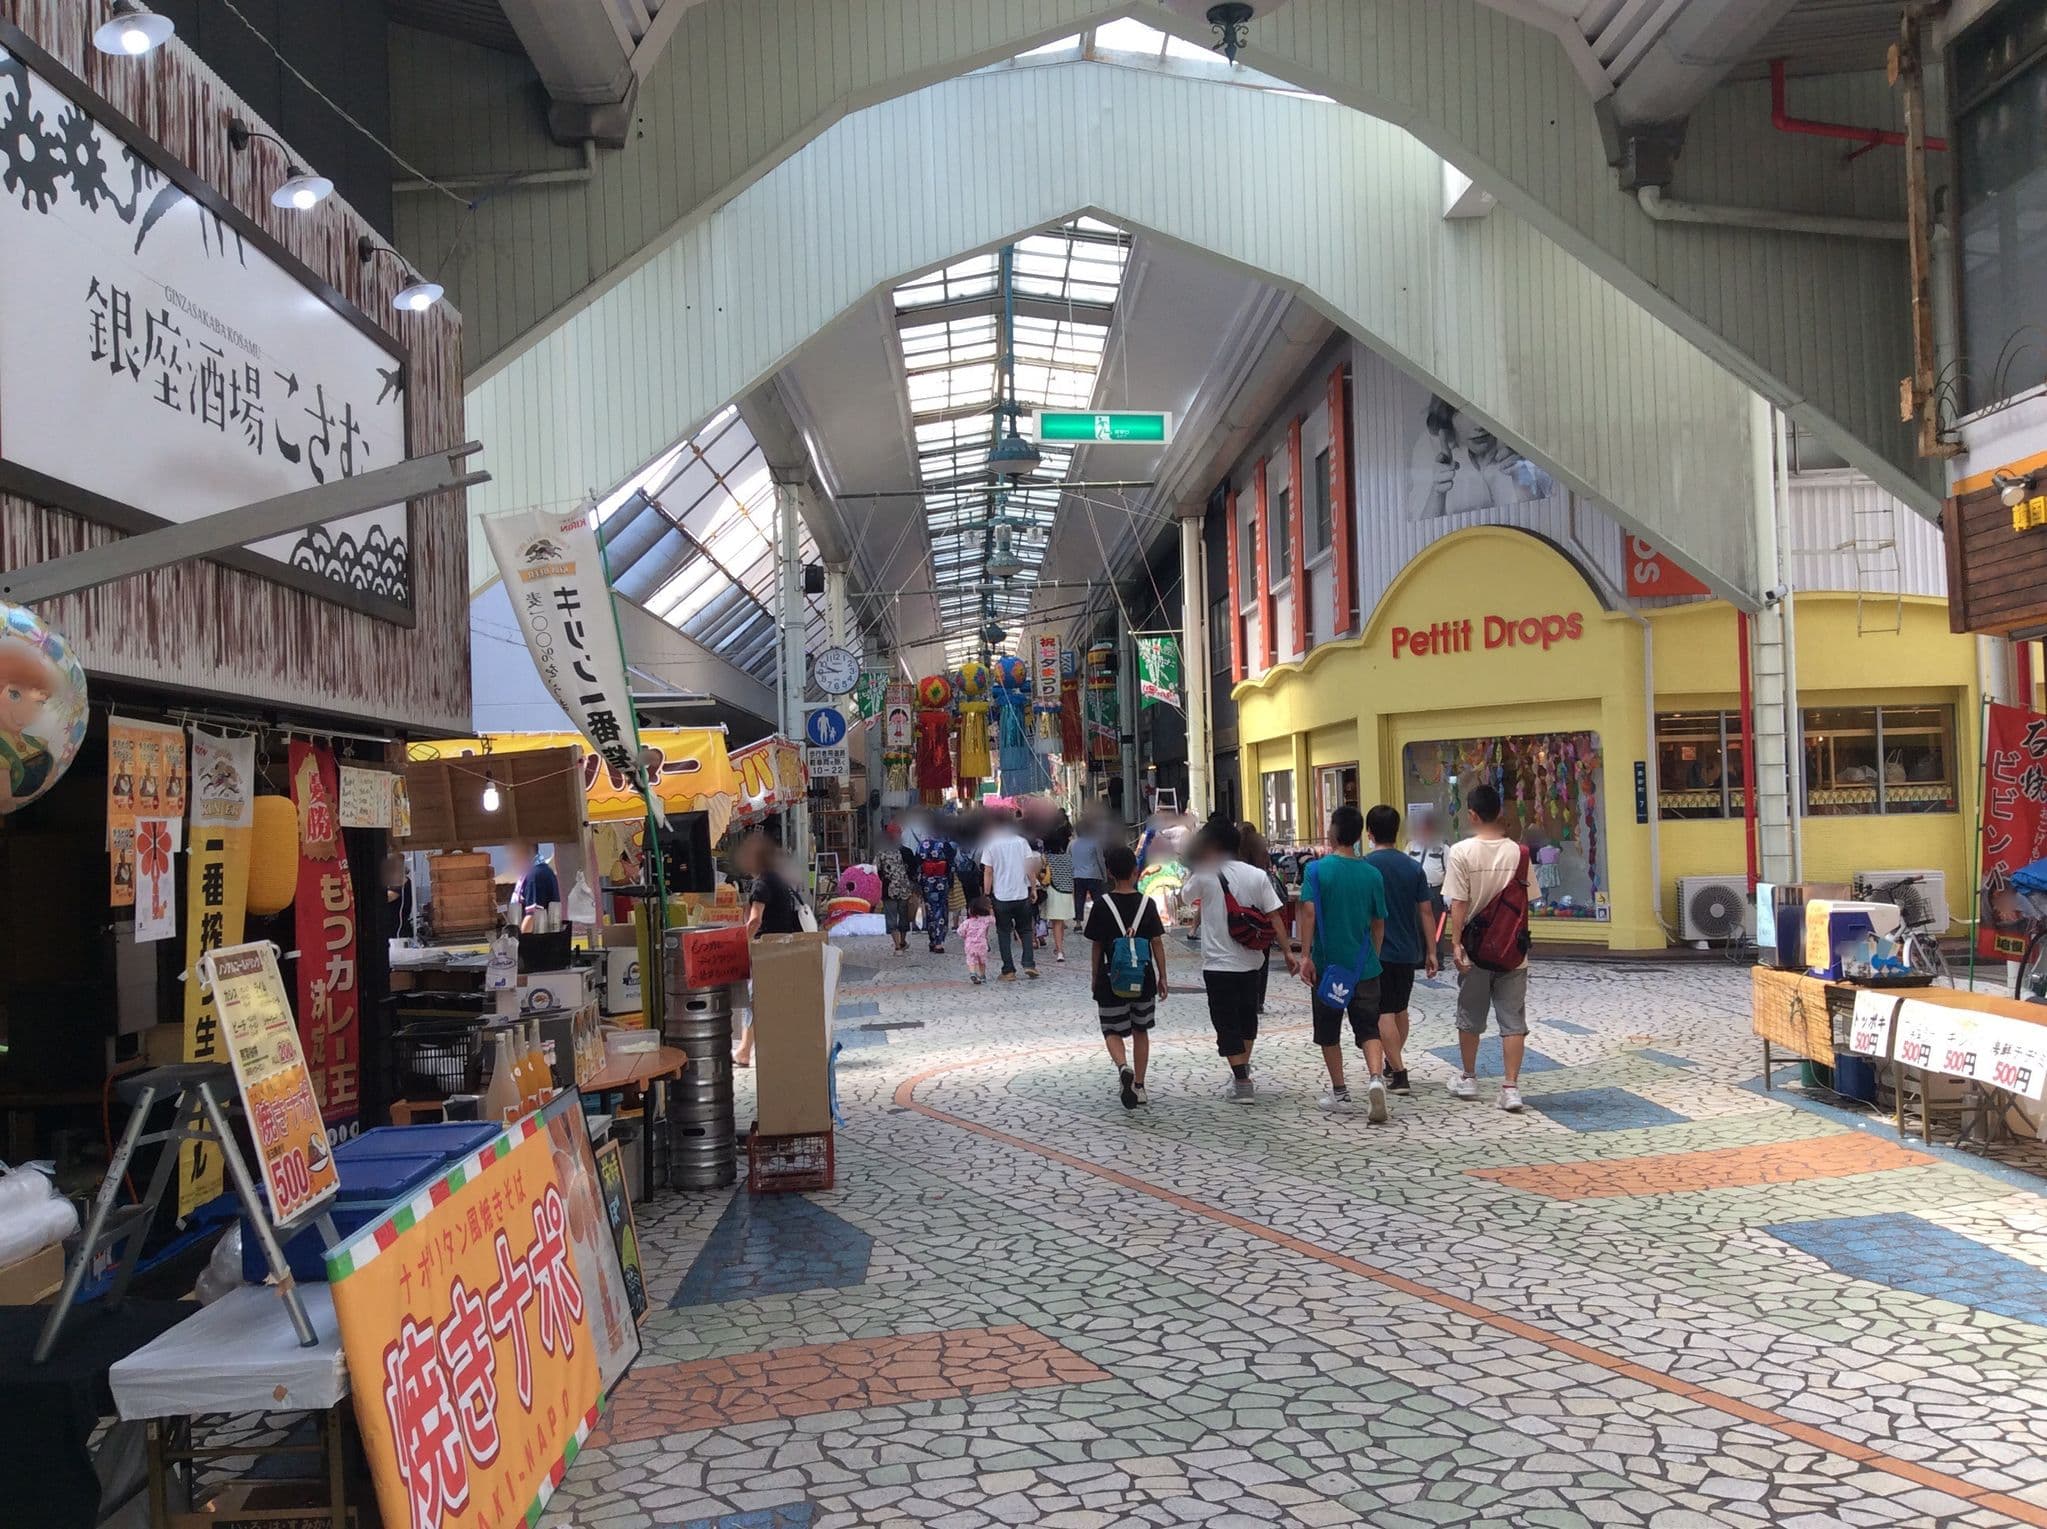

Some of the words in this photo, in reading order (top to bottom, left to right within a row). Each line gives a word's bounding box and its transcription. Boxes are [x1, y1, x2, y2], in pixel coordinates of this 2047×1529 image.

[1392, 618, 1473, 659] Pettit
[1484, 611, 1584, 651] Drops
[1040, 638, 1057, 694] 祝七夕まつり
[1984, 750, 2020, 891] ビビンバ
[320, 873, 358, 1105] もつカレー王
[1855, 1031, 1879, 1054] 500円
[1902, 1039, 1931, 1067] 500円
[1944, 1049, 1977, 1076] 500円
[1993, 1061, 2032, 1093] 500円
[270, 1147, 310, 1211] 500
[400, 1168, 526, 1305] ナポリタン風焼きそば
[384, 1182, 584, 1529] 焼きナポ
